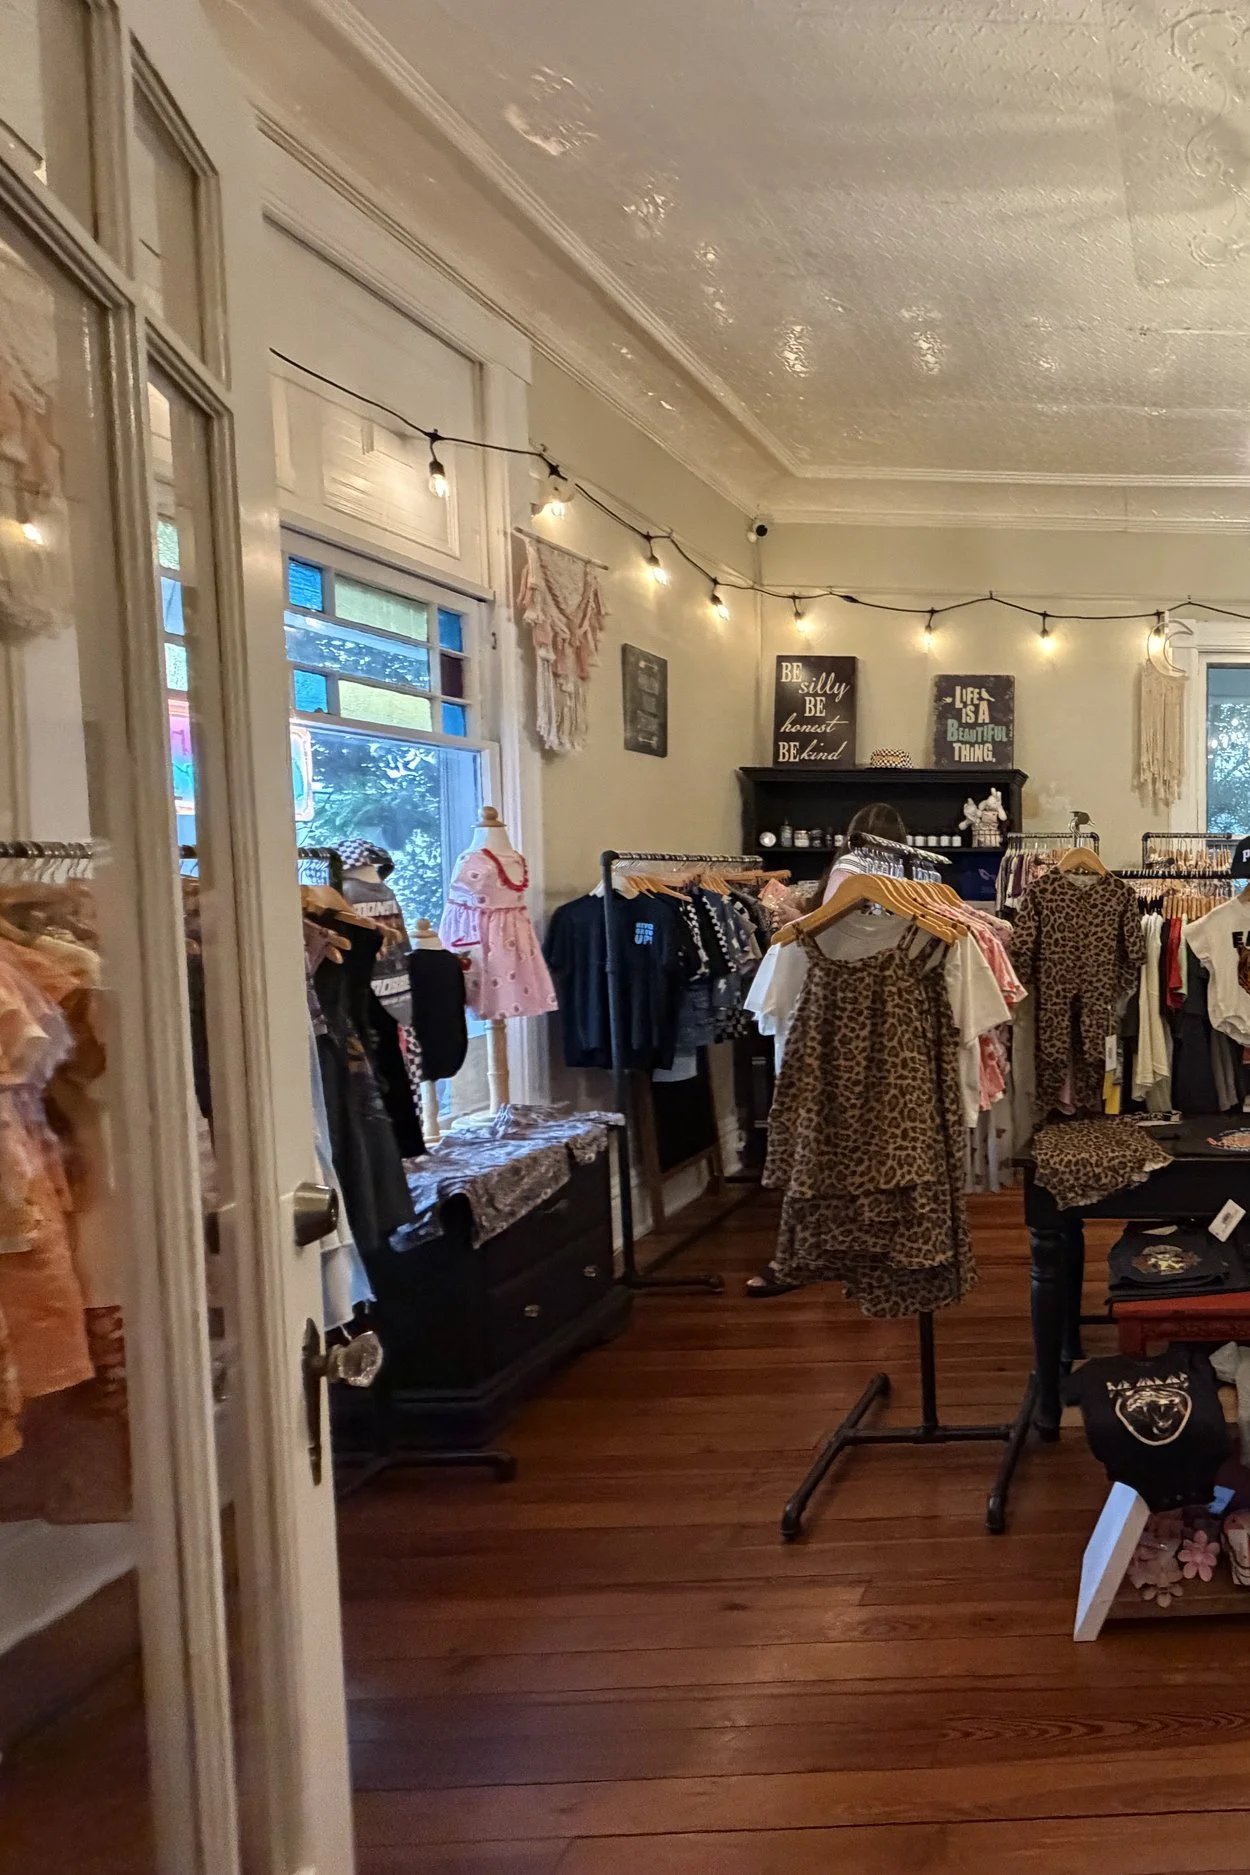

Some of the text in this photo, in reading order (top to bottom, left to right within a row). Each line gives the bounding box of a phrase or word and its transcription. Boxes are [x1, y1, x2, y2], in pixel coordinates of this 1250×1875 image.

[781, 662, 802, 682] BE
[798, 672, 850, 702] silly
[955, 686, 980, 708] LIFE
[804, 696, 826, 717] BE
[962, 700, 990, 723] IS A
[780, 712, 849, 733] honest
[947, 718, 1008, 742] BEAUTIFUL
[778, 739, 848, 762] BE kind
[953, 742, 997, 763] THING.
